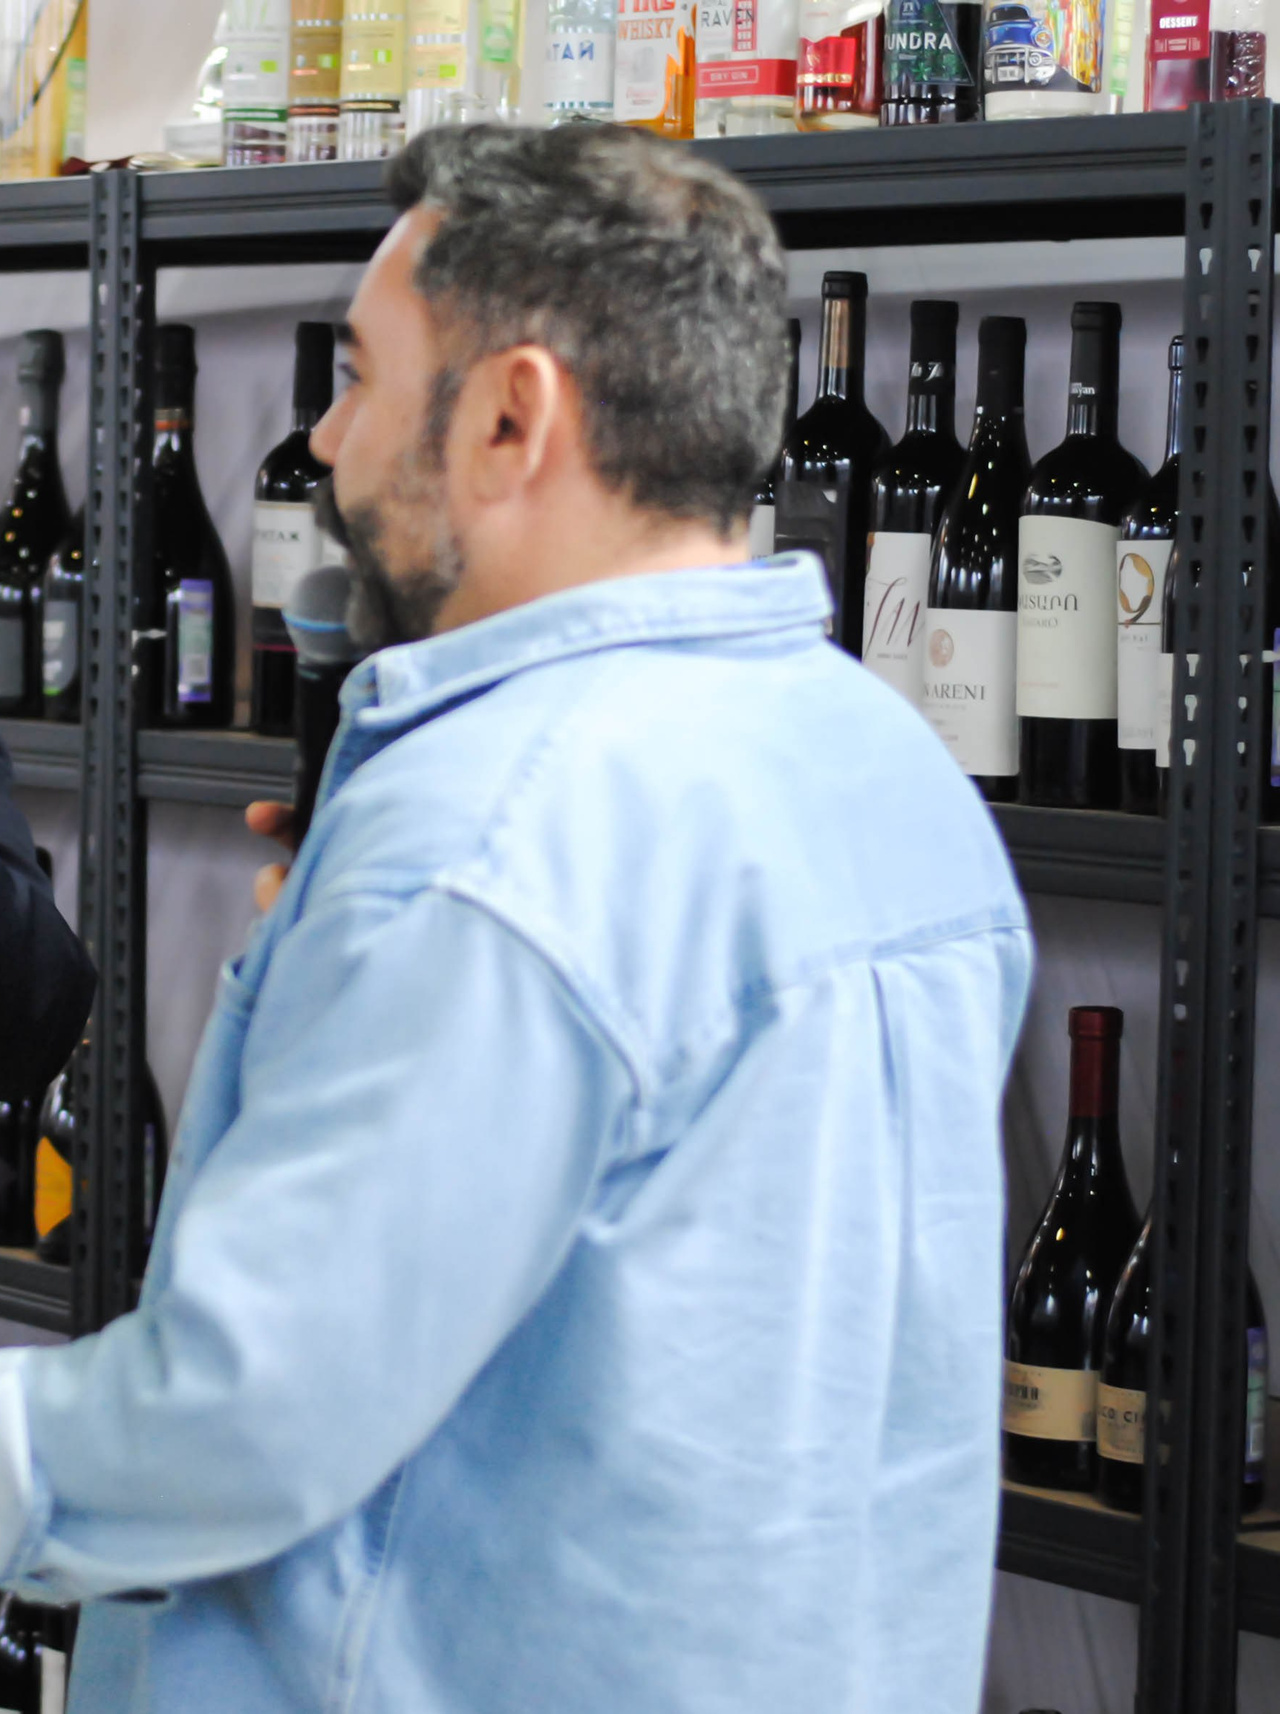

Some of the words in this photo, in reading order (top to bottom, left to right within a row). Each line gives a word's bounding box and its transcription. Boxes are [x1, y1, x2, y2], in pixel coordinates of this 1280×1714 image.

[701, 8, 754, 28] RAVEN
[1159, 15, 1198, 29] DESSERT
[618, 17, 674, 40] WHISKY
